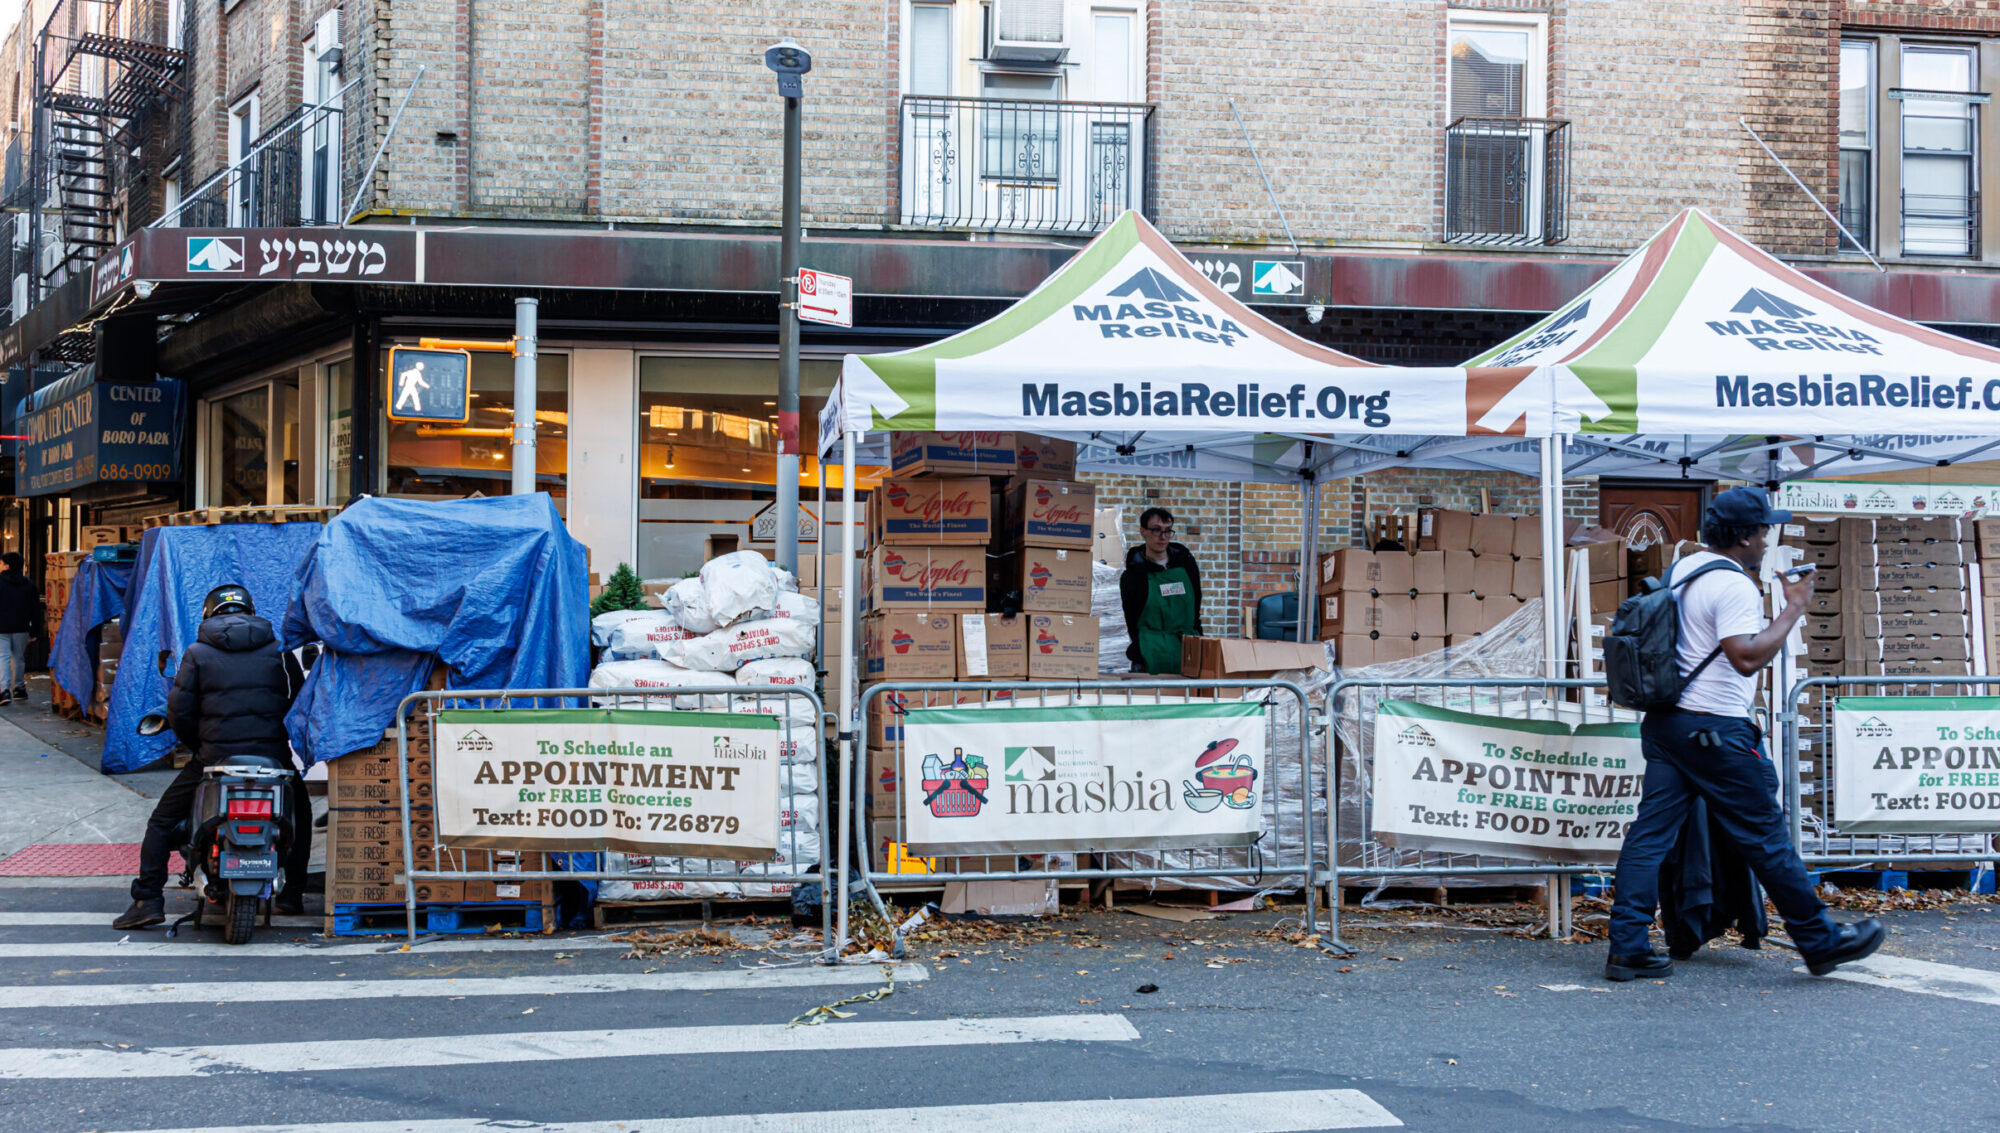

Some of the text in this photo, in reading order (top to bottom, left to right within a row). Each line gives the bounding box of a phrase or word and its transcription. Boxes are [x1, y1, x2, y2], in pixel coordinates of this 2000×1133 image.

[1072, 302, 1249, 338] MASBIA
[1099, 322, 1236, 347] Relief
[1704, 319, 1884, 344] MASBIA
[1745, 337, 1884, 356] Relief
[110, 385, 162, 402] CENTER
[63, 390, 92, 434] CENTER
[1021, 382, 1392, 428] MasbiaRelief.Org
[102, 430, 170, 445] BORO PARK
[99, 463, 171, 480] 686-0909
[903, 491, 987, 523] Apples
[1786, 494, 1838, 508] masbia
[1032, 505, 1090, 526] Apples
[899, 560, 983, 591] Apples
[1936, 726, 1958, 741] To
[537, 740, 673, 758] To Schedule an
[713, 744, 767, 761] masbia
[1482, 742, 1627, 769] To Schedule an
[364, 763, 386, 777] FRESH
[473, 760, 741, 791] APPOINTMENT
[1412, 756, 1645, 798] APPOINTME
[1918, 772, 2000, 787] for FREE
[364, 785, 386, 798] FRESH
[518, 788, 693, 808] for FREE Groceries
[1004, 765, 1177, 815] masbia
[1457, 787, 1635, 816] for FREE Groceries
[1871, 792, 2000, 810] Text: FOOD
[473, 808, 740, 835] Text: FOOD To: 726879
[1409, 804, 1469, 828] Text:
[1474, 810, 1550, 836] FOOD
[1556, 819, 1590, 838] To:
[363, 826, 386, 839] FRESH
[363, 847, 385, 860] FRESH
[363, 867, 385, 881] FRESH
[363, 887, 385, 901] FRESH
[632, 881, 661, 890] SPECIAL
